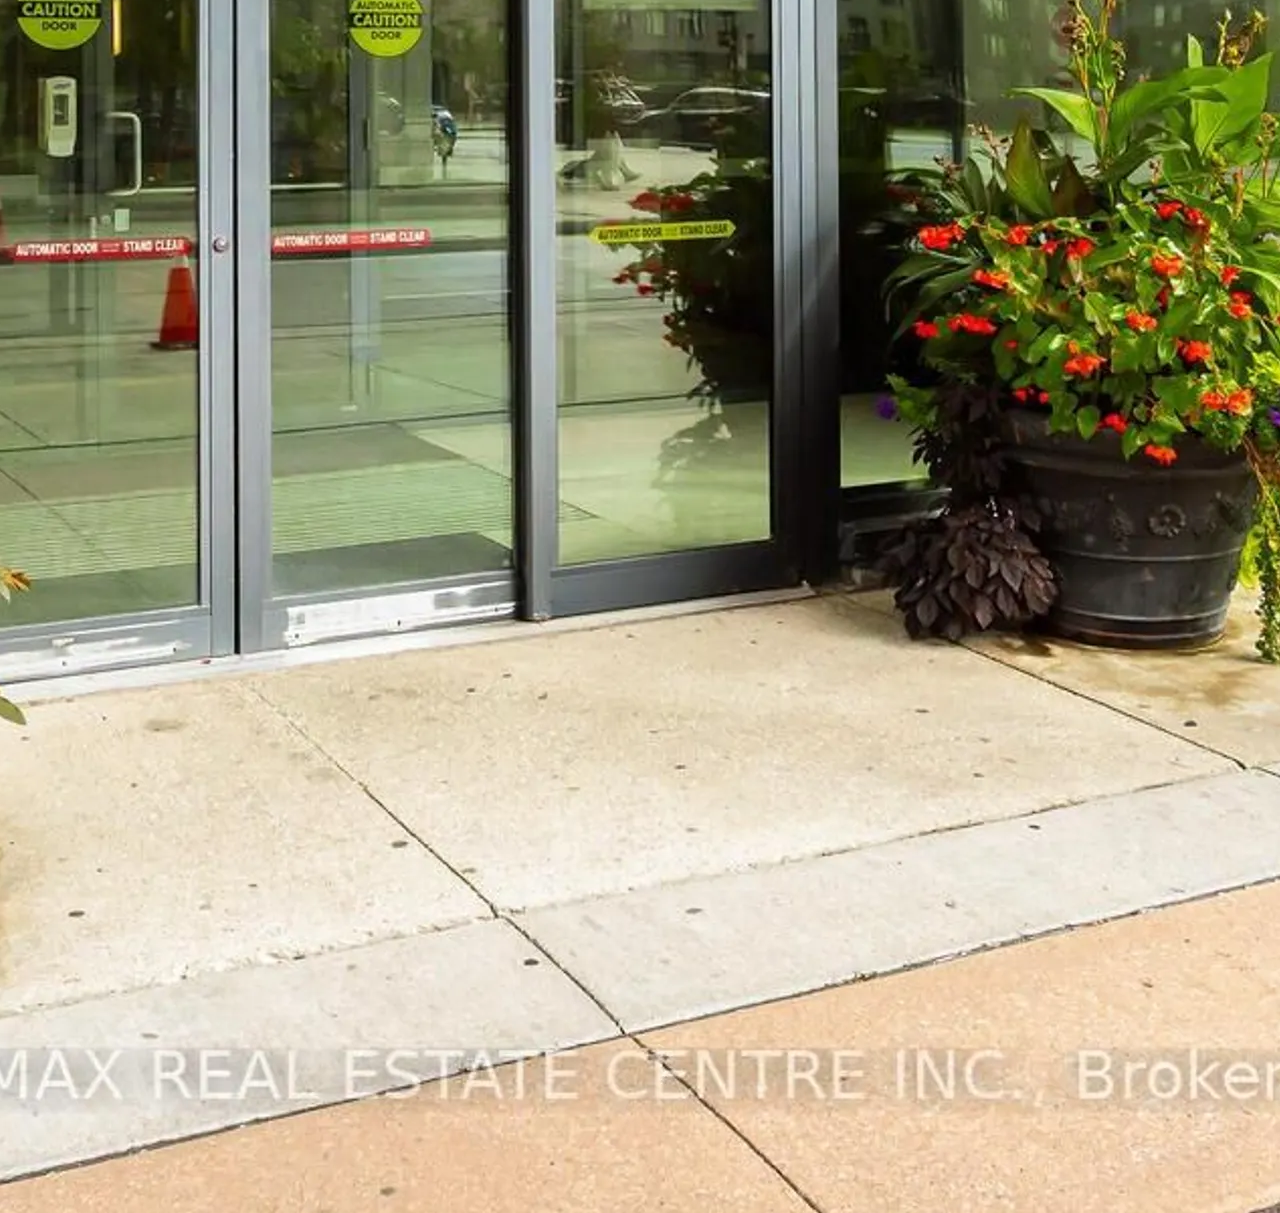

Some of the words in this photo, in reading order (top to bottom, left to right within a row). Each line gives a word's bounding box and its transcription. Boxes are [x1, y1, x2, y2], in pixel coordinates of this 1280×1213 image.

[21, 2, 96, 17] CAUTION
[358, 0, 416, 10] AUTOMATIC
[41, 20, 77, 32] DOOR
[353, 14, 419, 27] CAUTION
[371, 31, 401, 41] DOOR
[273, 234, 323, 248] AUTOMATIC
[325, 233, 347, 245] DOOR
[16, 243, 70, 257] AUTOMATIC
[72, 242, 99, 255] DOOR
[123, 240, 153, 253] STAND
[155, 239, 185, 251] CLEAR
